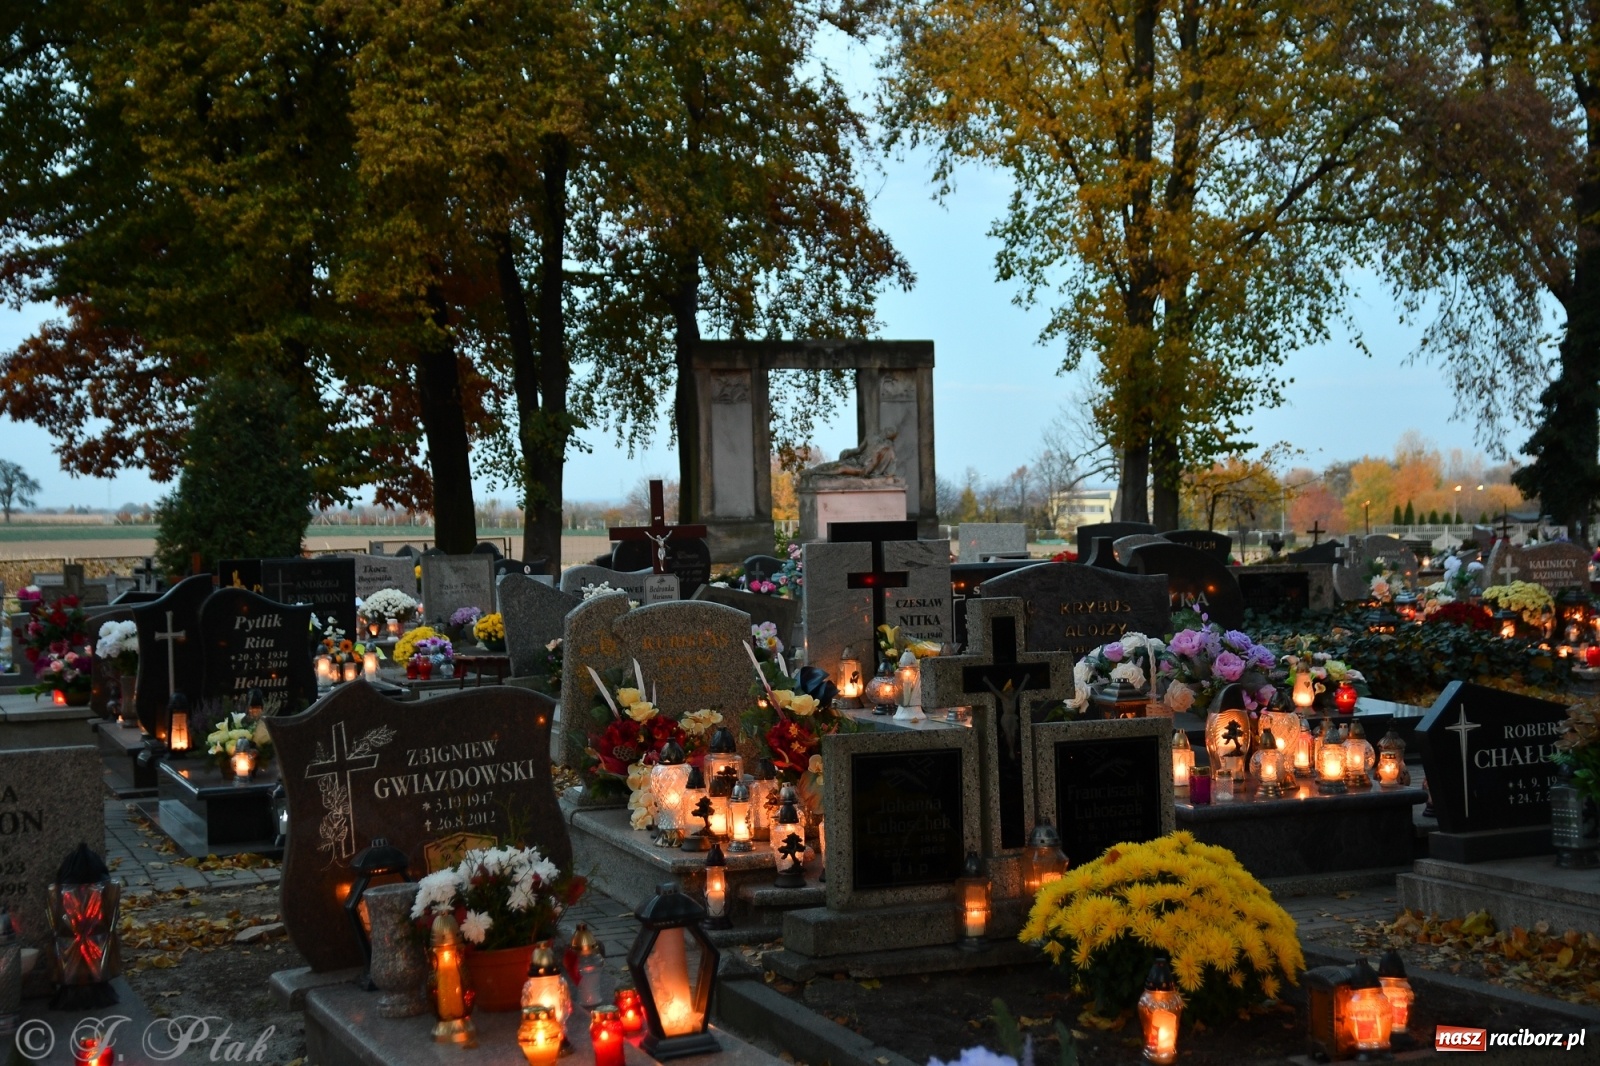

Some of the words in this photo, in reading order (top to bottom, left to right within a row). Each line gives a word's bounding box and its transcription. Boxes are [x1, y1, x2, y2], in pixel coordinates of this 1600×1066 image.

[296, 579, 340, 589] ANDRZEJ
[896, 598, 943, 608] CZESŁAW
[1060, 600, 1131, 615] KRYBUS
[234, 613, 282, 633] Pytlik
[900, 614, 941, 626] NITKA
[1065, 623, 1128, 637] ALOJZY
[244, 636, 275, 649] Rita
[233, 675, 288, 690] Helmut
[1504, 721, 1558, 739] ROBER
[406, 739, 499, 767] ZBIGNIEW
[1474, 744, 1560, 769] CHAŁU
[373, 758, 535, 799] GWIAZDOWSKI
